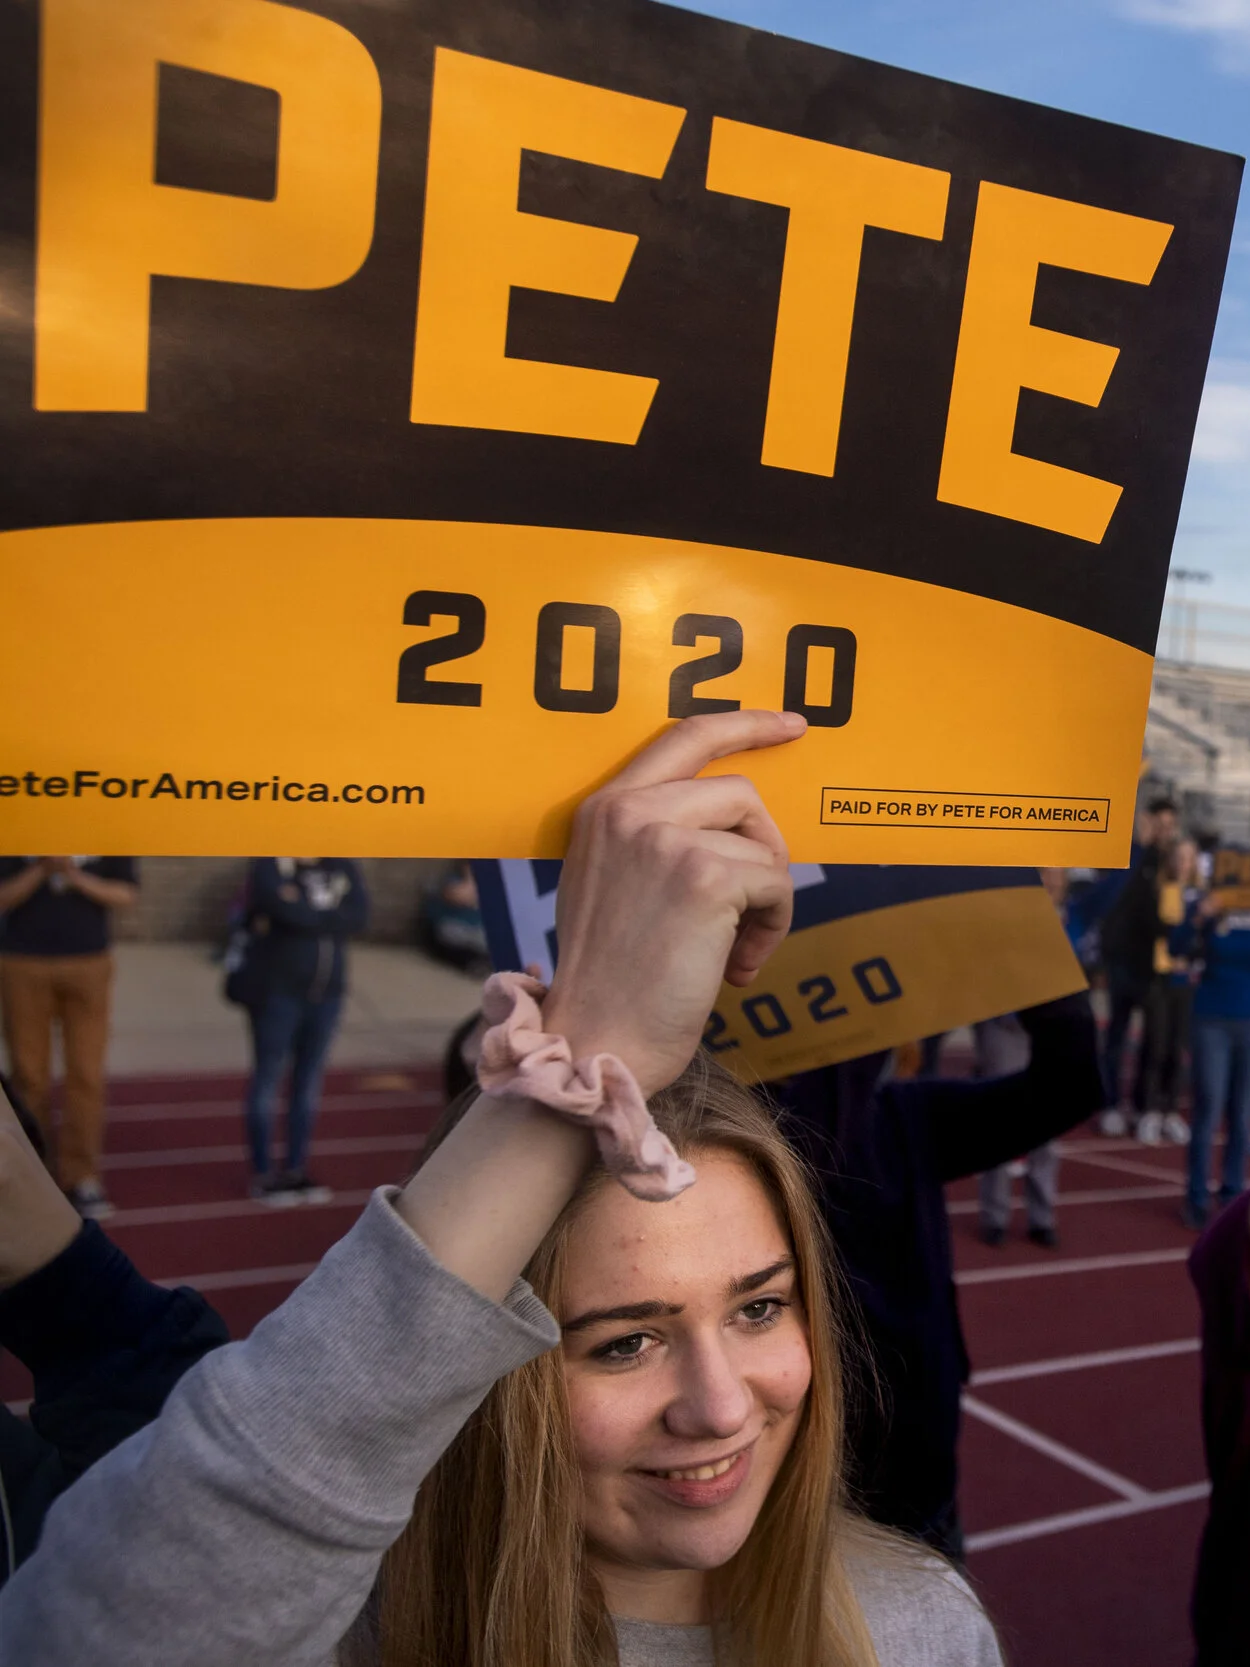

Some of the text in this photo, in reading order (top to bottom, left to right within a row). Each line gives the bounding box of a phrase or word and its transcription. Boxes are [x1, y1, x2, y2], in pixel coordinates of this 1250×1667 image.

[34, 0, 1175, 545] PETE
[396, 589, 858, 729] 2020
[830, 800, 1101, 822] PAID FOR BY PETE FOR AMERICA
[701, 955, 904, 1052] 2020
